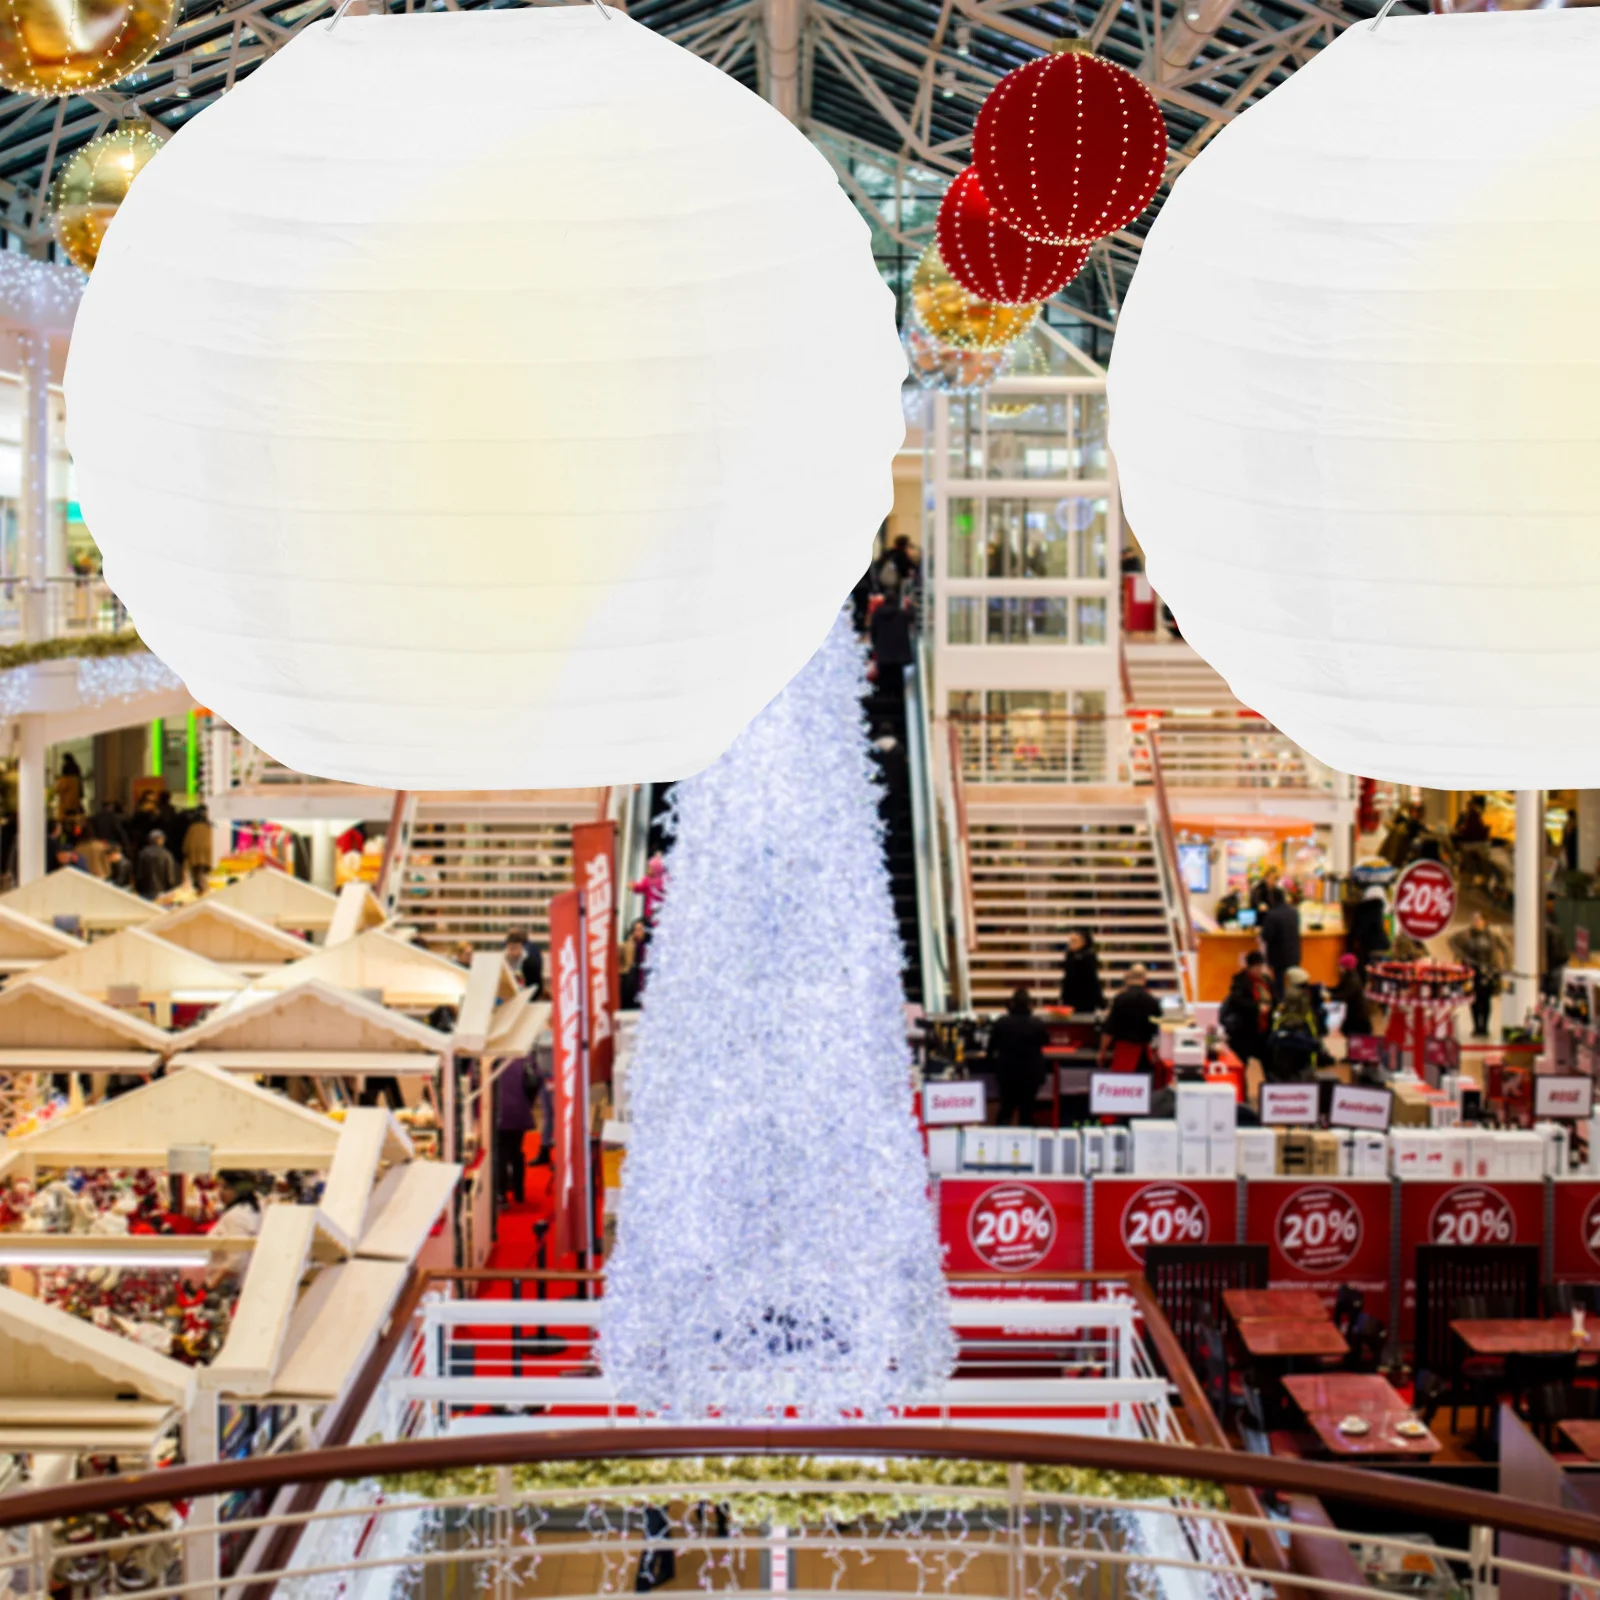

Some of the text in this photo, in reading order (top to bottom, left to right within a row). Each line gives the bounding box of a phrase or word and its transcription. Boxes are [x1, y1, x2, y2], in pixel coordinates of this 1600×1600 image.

[1398, 881, 1454, 917] 20%
[931, 1094, 976, 1110] Suisse
[1097, 1082, 1145, 1099] France
[975, 1205, 1050, 1246] 20%
[1128, 1204, 1204, 1246] 20%
[1282, 1206, 1357, 1248] 20%
[1436, 1205, 1510, 1245] 20%
